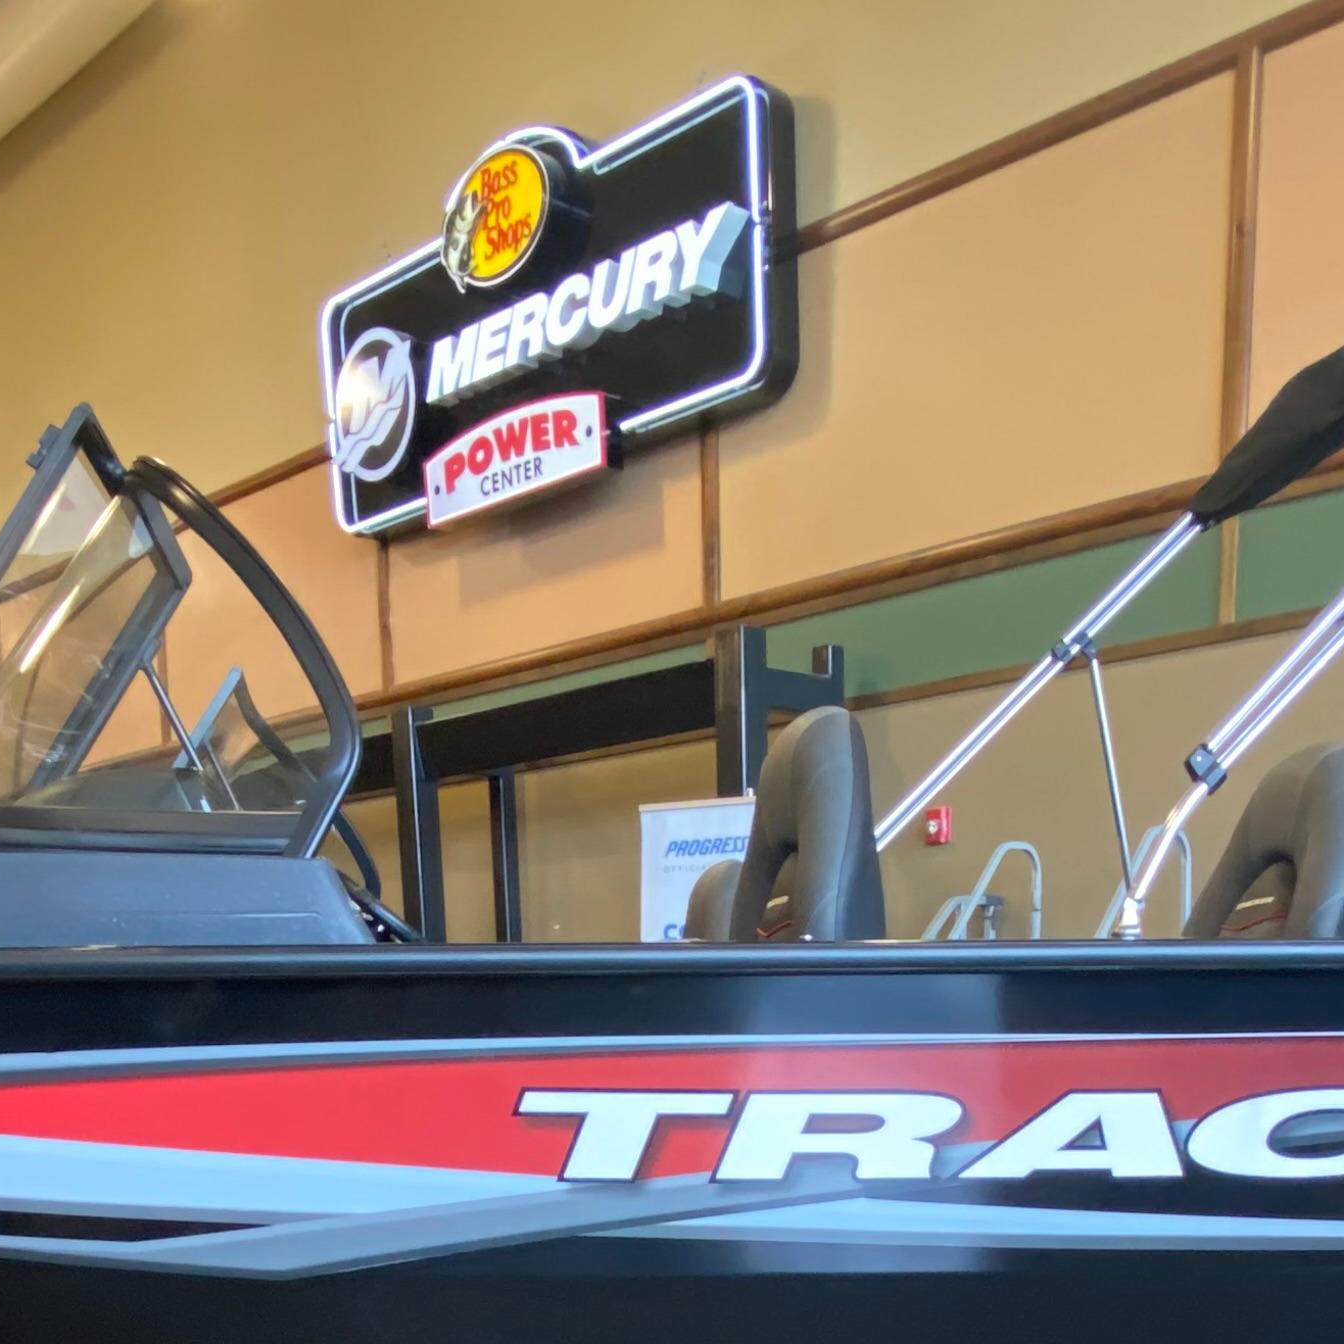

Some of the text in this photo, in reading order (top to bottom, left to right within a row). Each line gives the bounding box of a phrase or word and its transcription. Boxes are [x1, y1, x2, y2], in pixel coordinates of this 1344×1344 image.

[481, 160, 518, 199] Bass
[483, 195, 511, 231] Pro
[485, 213, 532, 260] Shops
[426, 202, 736, 405] MERCURY
[442, 410, 580, 493] POWER
[480, 458, 544, 497] CENTER
